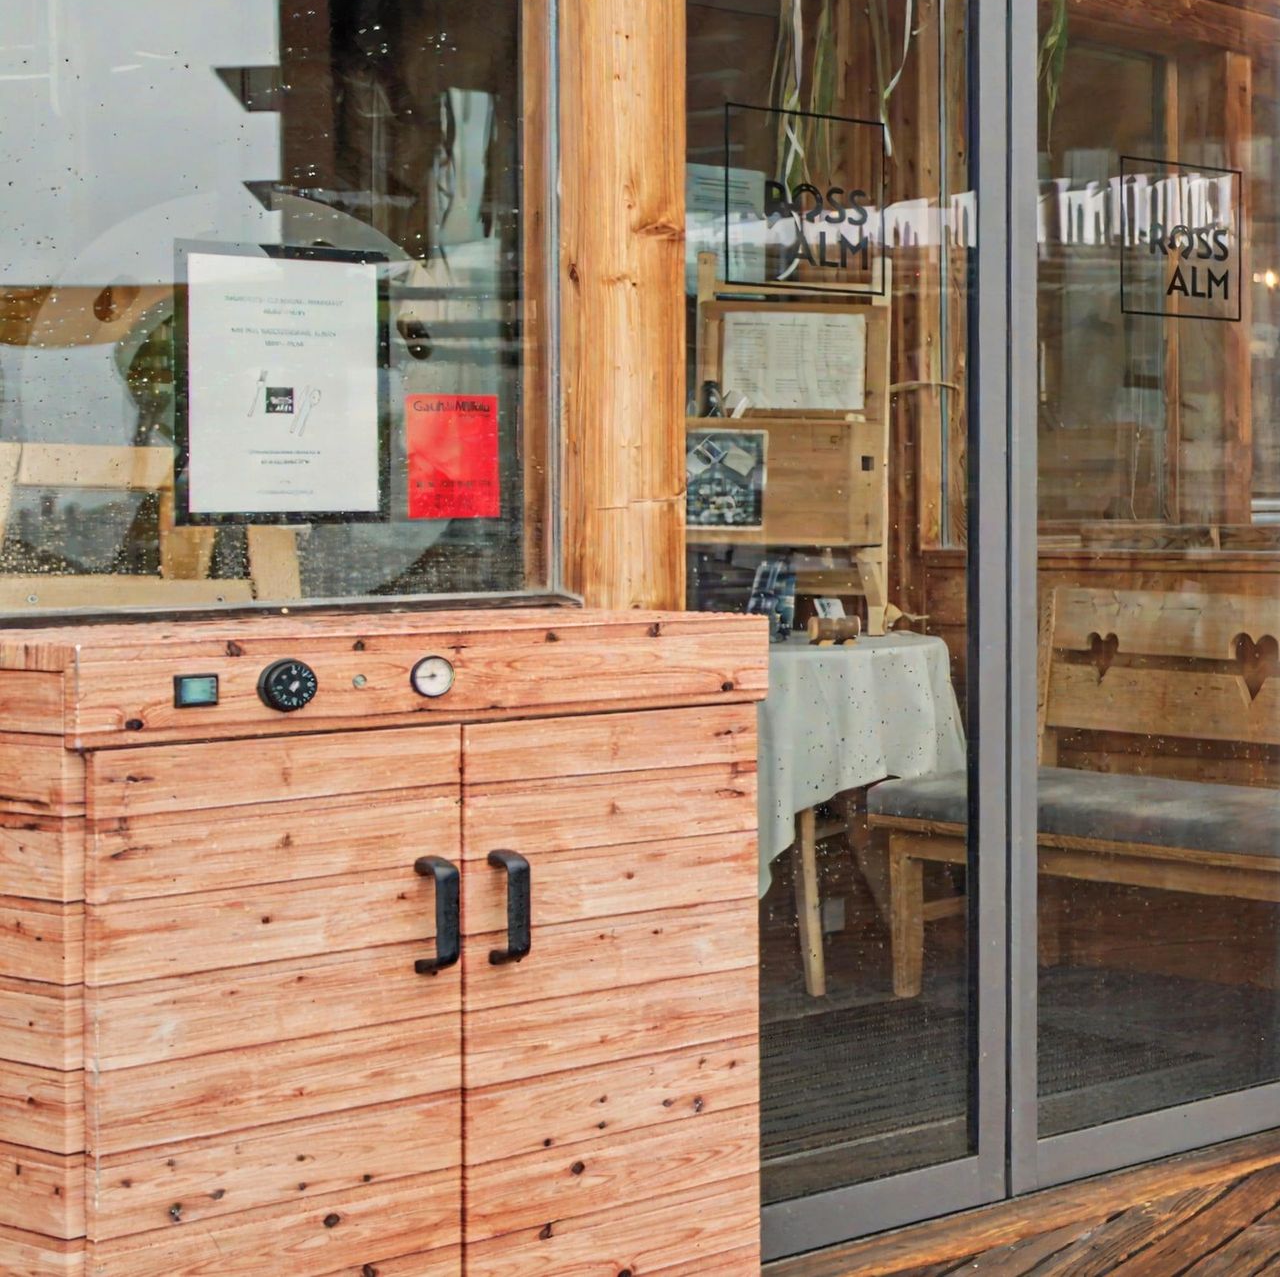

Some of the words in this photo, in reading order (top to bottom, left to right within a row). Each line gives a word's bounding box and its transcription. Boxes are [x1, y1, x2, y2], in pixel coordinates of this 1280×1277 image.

[786, 226, 868, 270] ALM
[1149, 223, 1229, 262] ROSS
[1166, 265, 1229, 300] ALM
